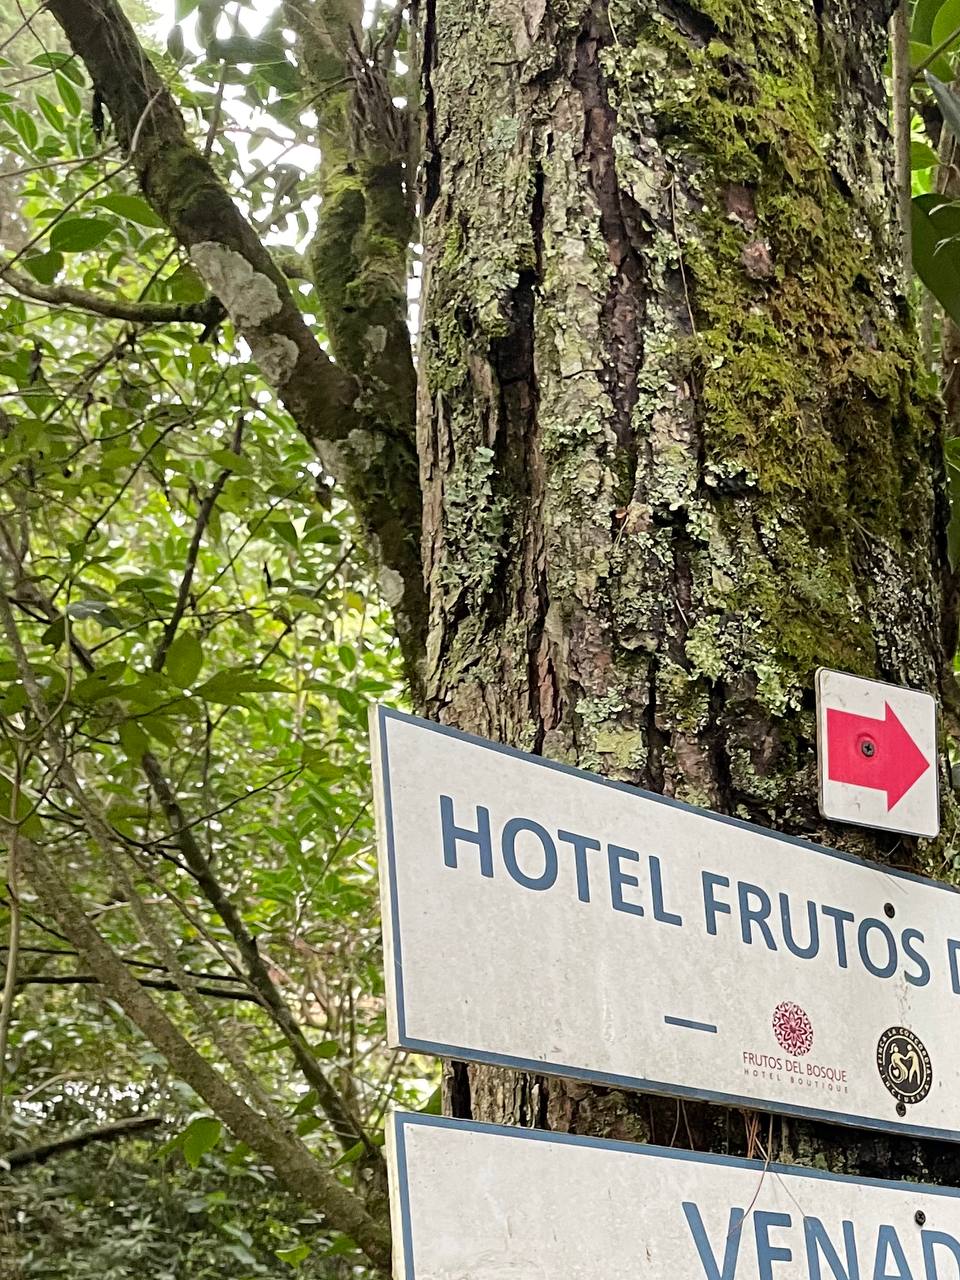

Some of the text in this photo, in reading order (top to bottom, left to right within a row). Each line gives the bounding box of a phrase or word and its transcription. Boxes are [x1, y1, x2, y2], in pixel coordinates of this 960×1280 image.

[439, 795, 682, 927] HOTEL
[703, 871, 931, 987] FRUTOS
[742, 1051, 848, 1083] FRUTOS DEL BOSQUE
[743, 1068, 848, 1094] HOTEL BOUTIQUE
